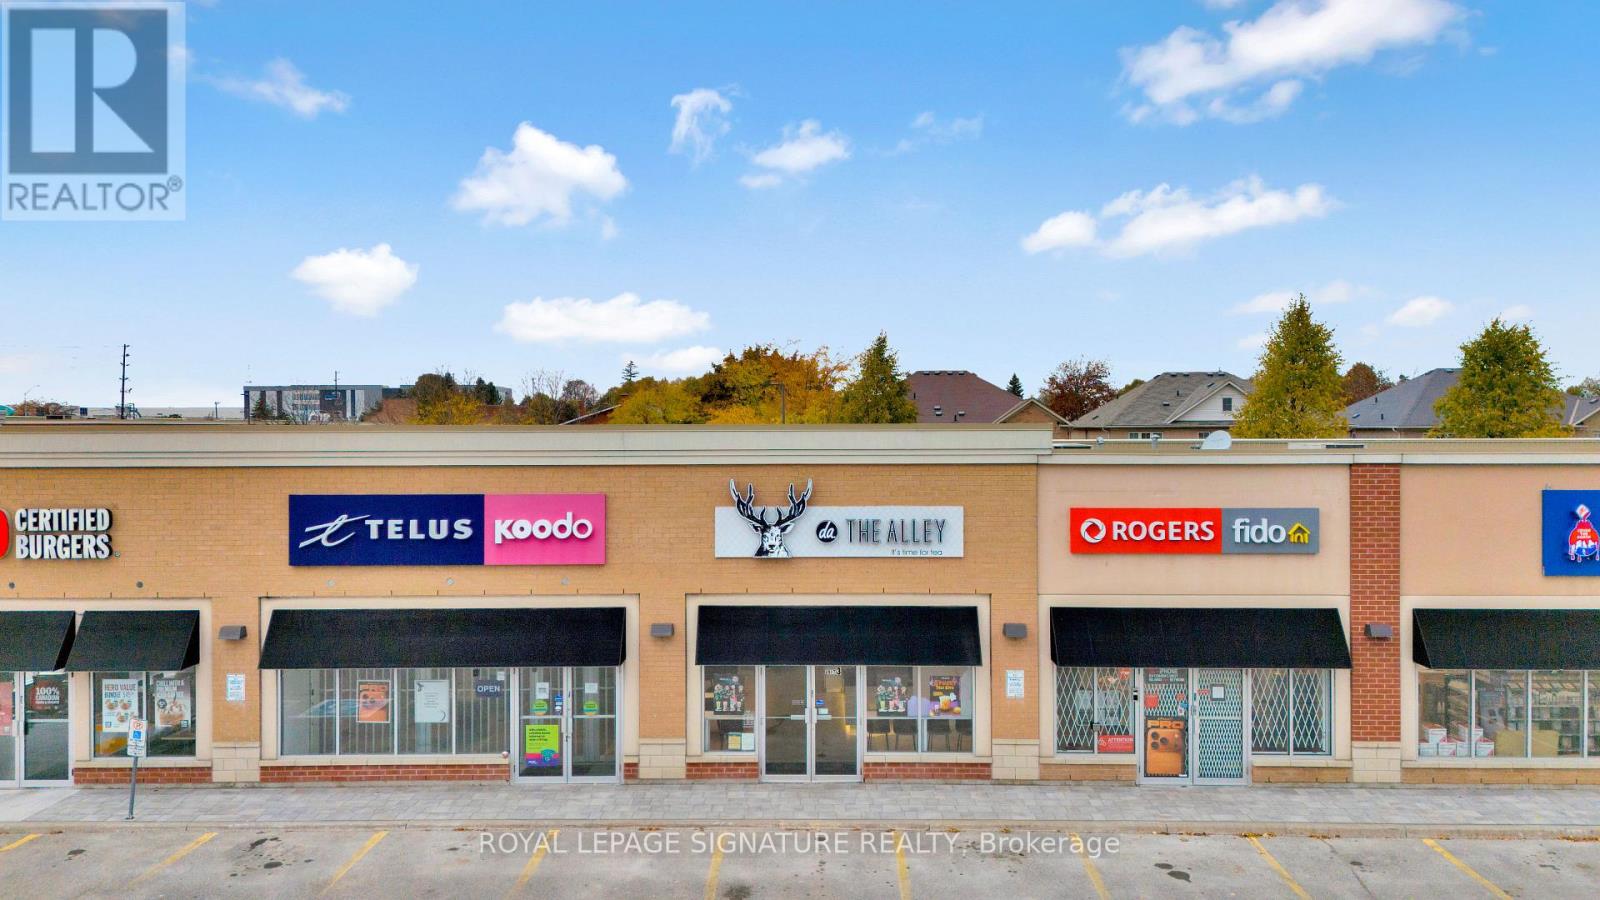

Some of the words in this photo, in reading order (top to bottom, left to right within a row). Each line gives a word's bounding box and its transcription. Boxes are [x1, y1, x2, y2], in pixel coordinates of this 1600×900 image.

[15, 508, 111, 532] CERTIFIED
[365, 518, 474, 540] TELUS
[818, 520, 836, 540] da
[846, 518, 880, 545] THE
[887, 518, 946, 545] ALLEY
[1112, 520, 1216, 542] ROGERS
[1232, 518, 1287, 544] fido
[15, 534, 111, 560] BURGERS
[477, 685, 501, 693] OPEN
